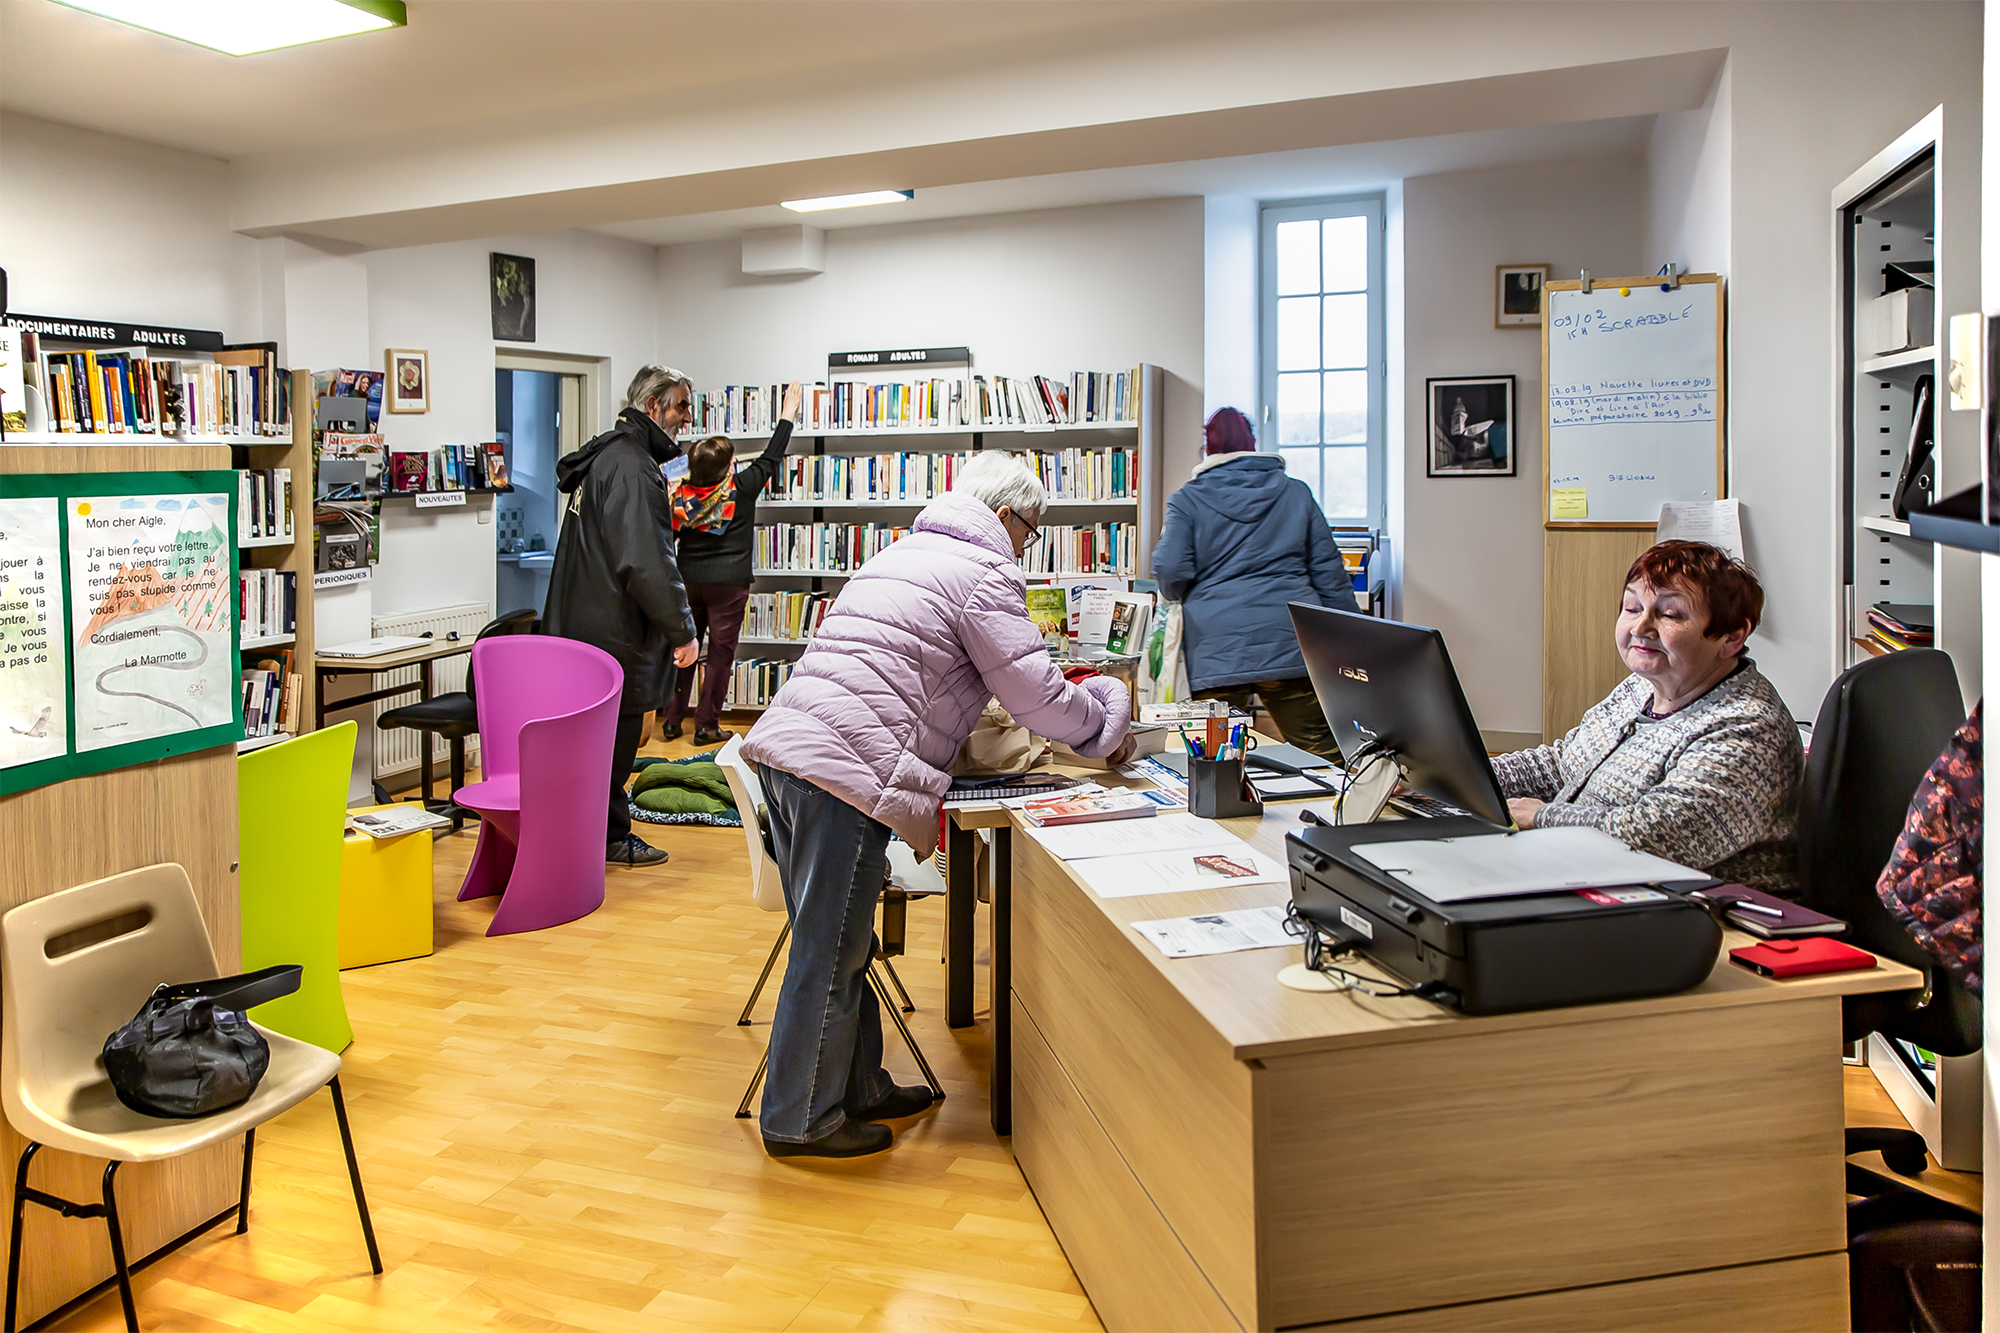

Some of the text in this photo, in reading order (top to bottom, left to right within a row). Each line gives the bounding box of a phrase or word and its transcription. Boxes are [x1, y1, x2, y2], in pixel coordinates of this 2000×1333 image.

[1553, 304, 1693, 333] 09/02 SCRABBLE
[7, 318, 187, 346] DOCUMENTAIRES ADULTES
[847, 350, 927, 363] ROMANS ADULTES
[1600, 380, 1643, 389] Navette
[1651, 378, 1679, 388] livres
[1693, 378, 1711, 388] DVD
[1609, 403, 1629, 412] Lire
[1654, 409, 1680, 419] 2019
[418, 494, 463, 503] NOUVEAUTES
[86, 516, 166, 528] Mon cher Aigle,
[87, 541, 211, 558] J'ai bien reçu votre lettre.
[36, 556, 43, 566] à
[87, 555, 215, 572] Je ne viendrai pas au
[34, 570, 44, 580] la
[88, 568, 216, 586] rendez-vous car je ne
[314, 571, 367, 585] PERIODIQUES
[19, 585, 45, 595] vous
[89, 581, 216, 601] suis pas stupide comme
[36, 598, 45, 608] la
[89, 604, 114, 615] vous
[37, 611, 46, 622] si
[21, 627, 46, 637] vous
[91, 627, 161, 644] Cordialement,
[4, 640, 47, 654] Je vous
[10, 656, 29, 669] pas
[34, 652, 47, 664] de
[125, 650, 187, 668] La Marmotte
[1339, 664, 1369, 683] ASUS
